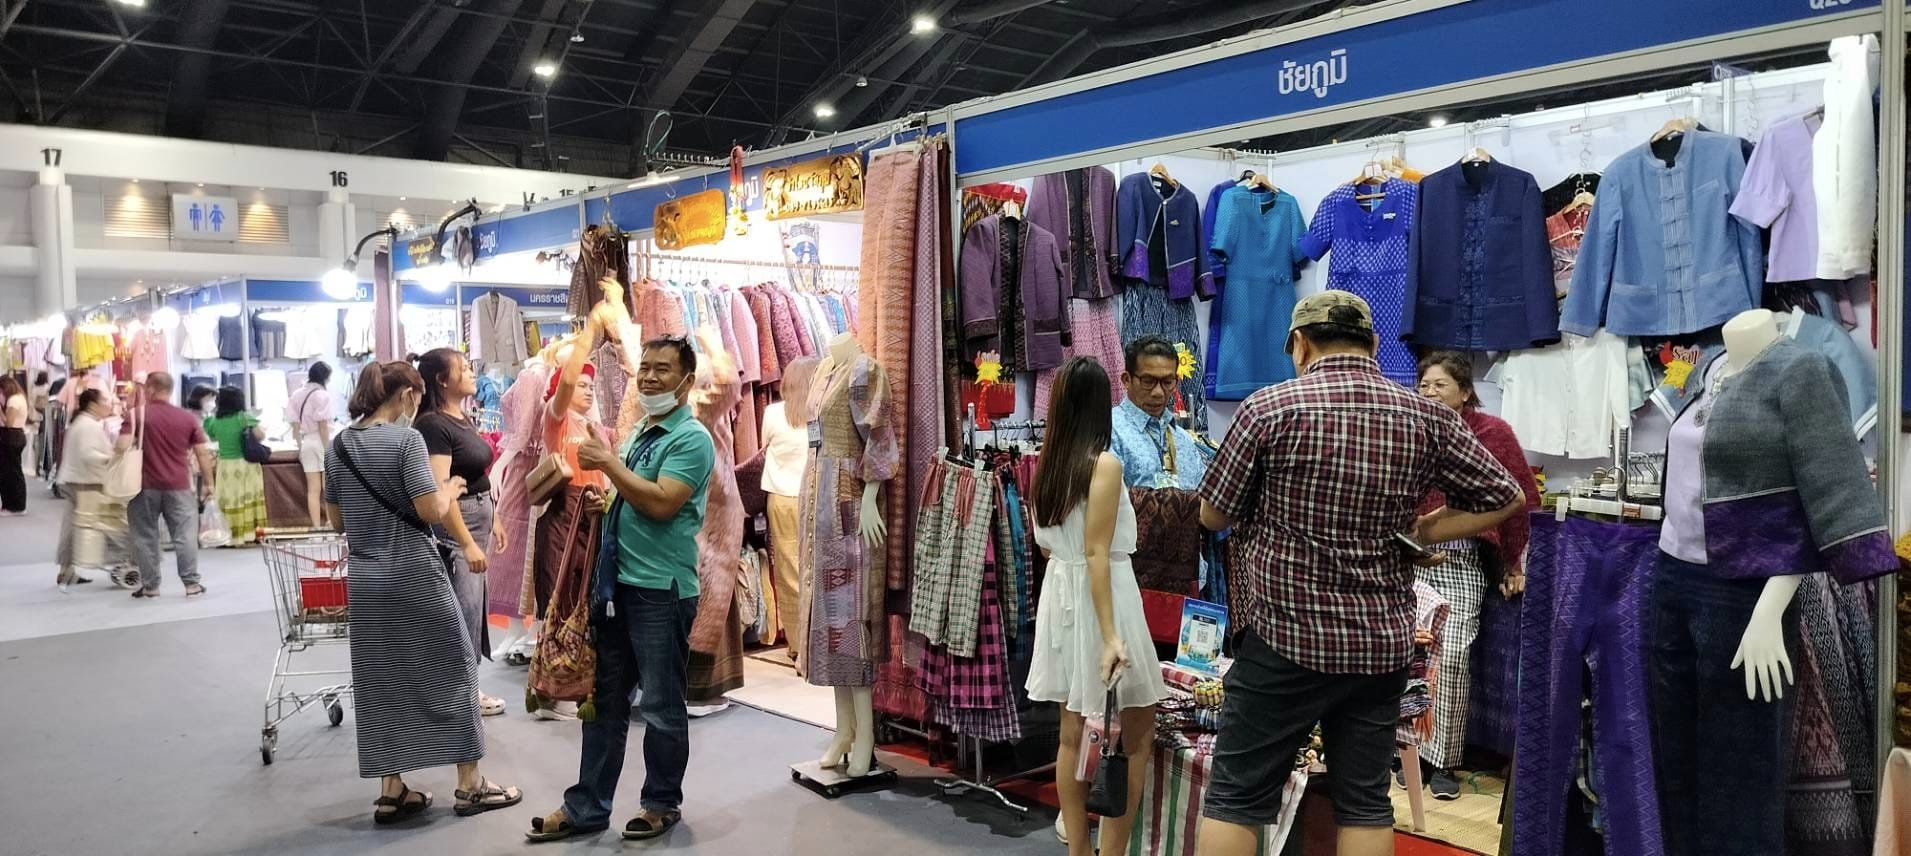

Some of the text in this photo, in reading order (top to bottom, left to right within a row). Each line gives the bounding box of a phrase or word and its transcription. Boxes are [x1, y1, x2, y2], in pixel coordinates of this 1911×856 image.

[1278, 48, 1347, 98] ชัยภูมิ
[40, 148, 62, 166] 17
[329, 170, 348, 187] 16
[529, 292, 569, 304] นครราชสี
